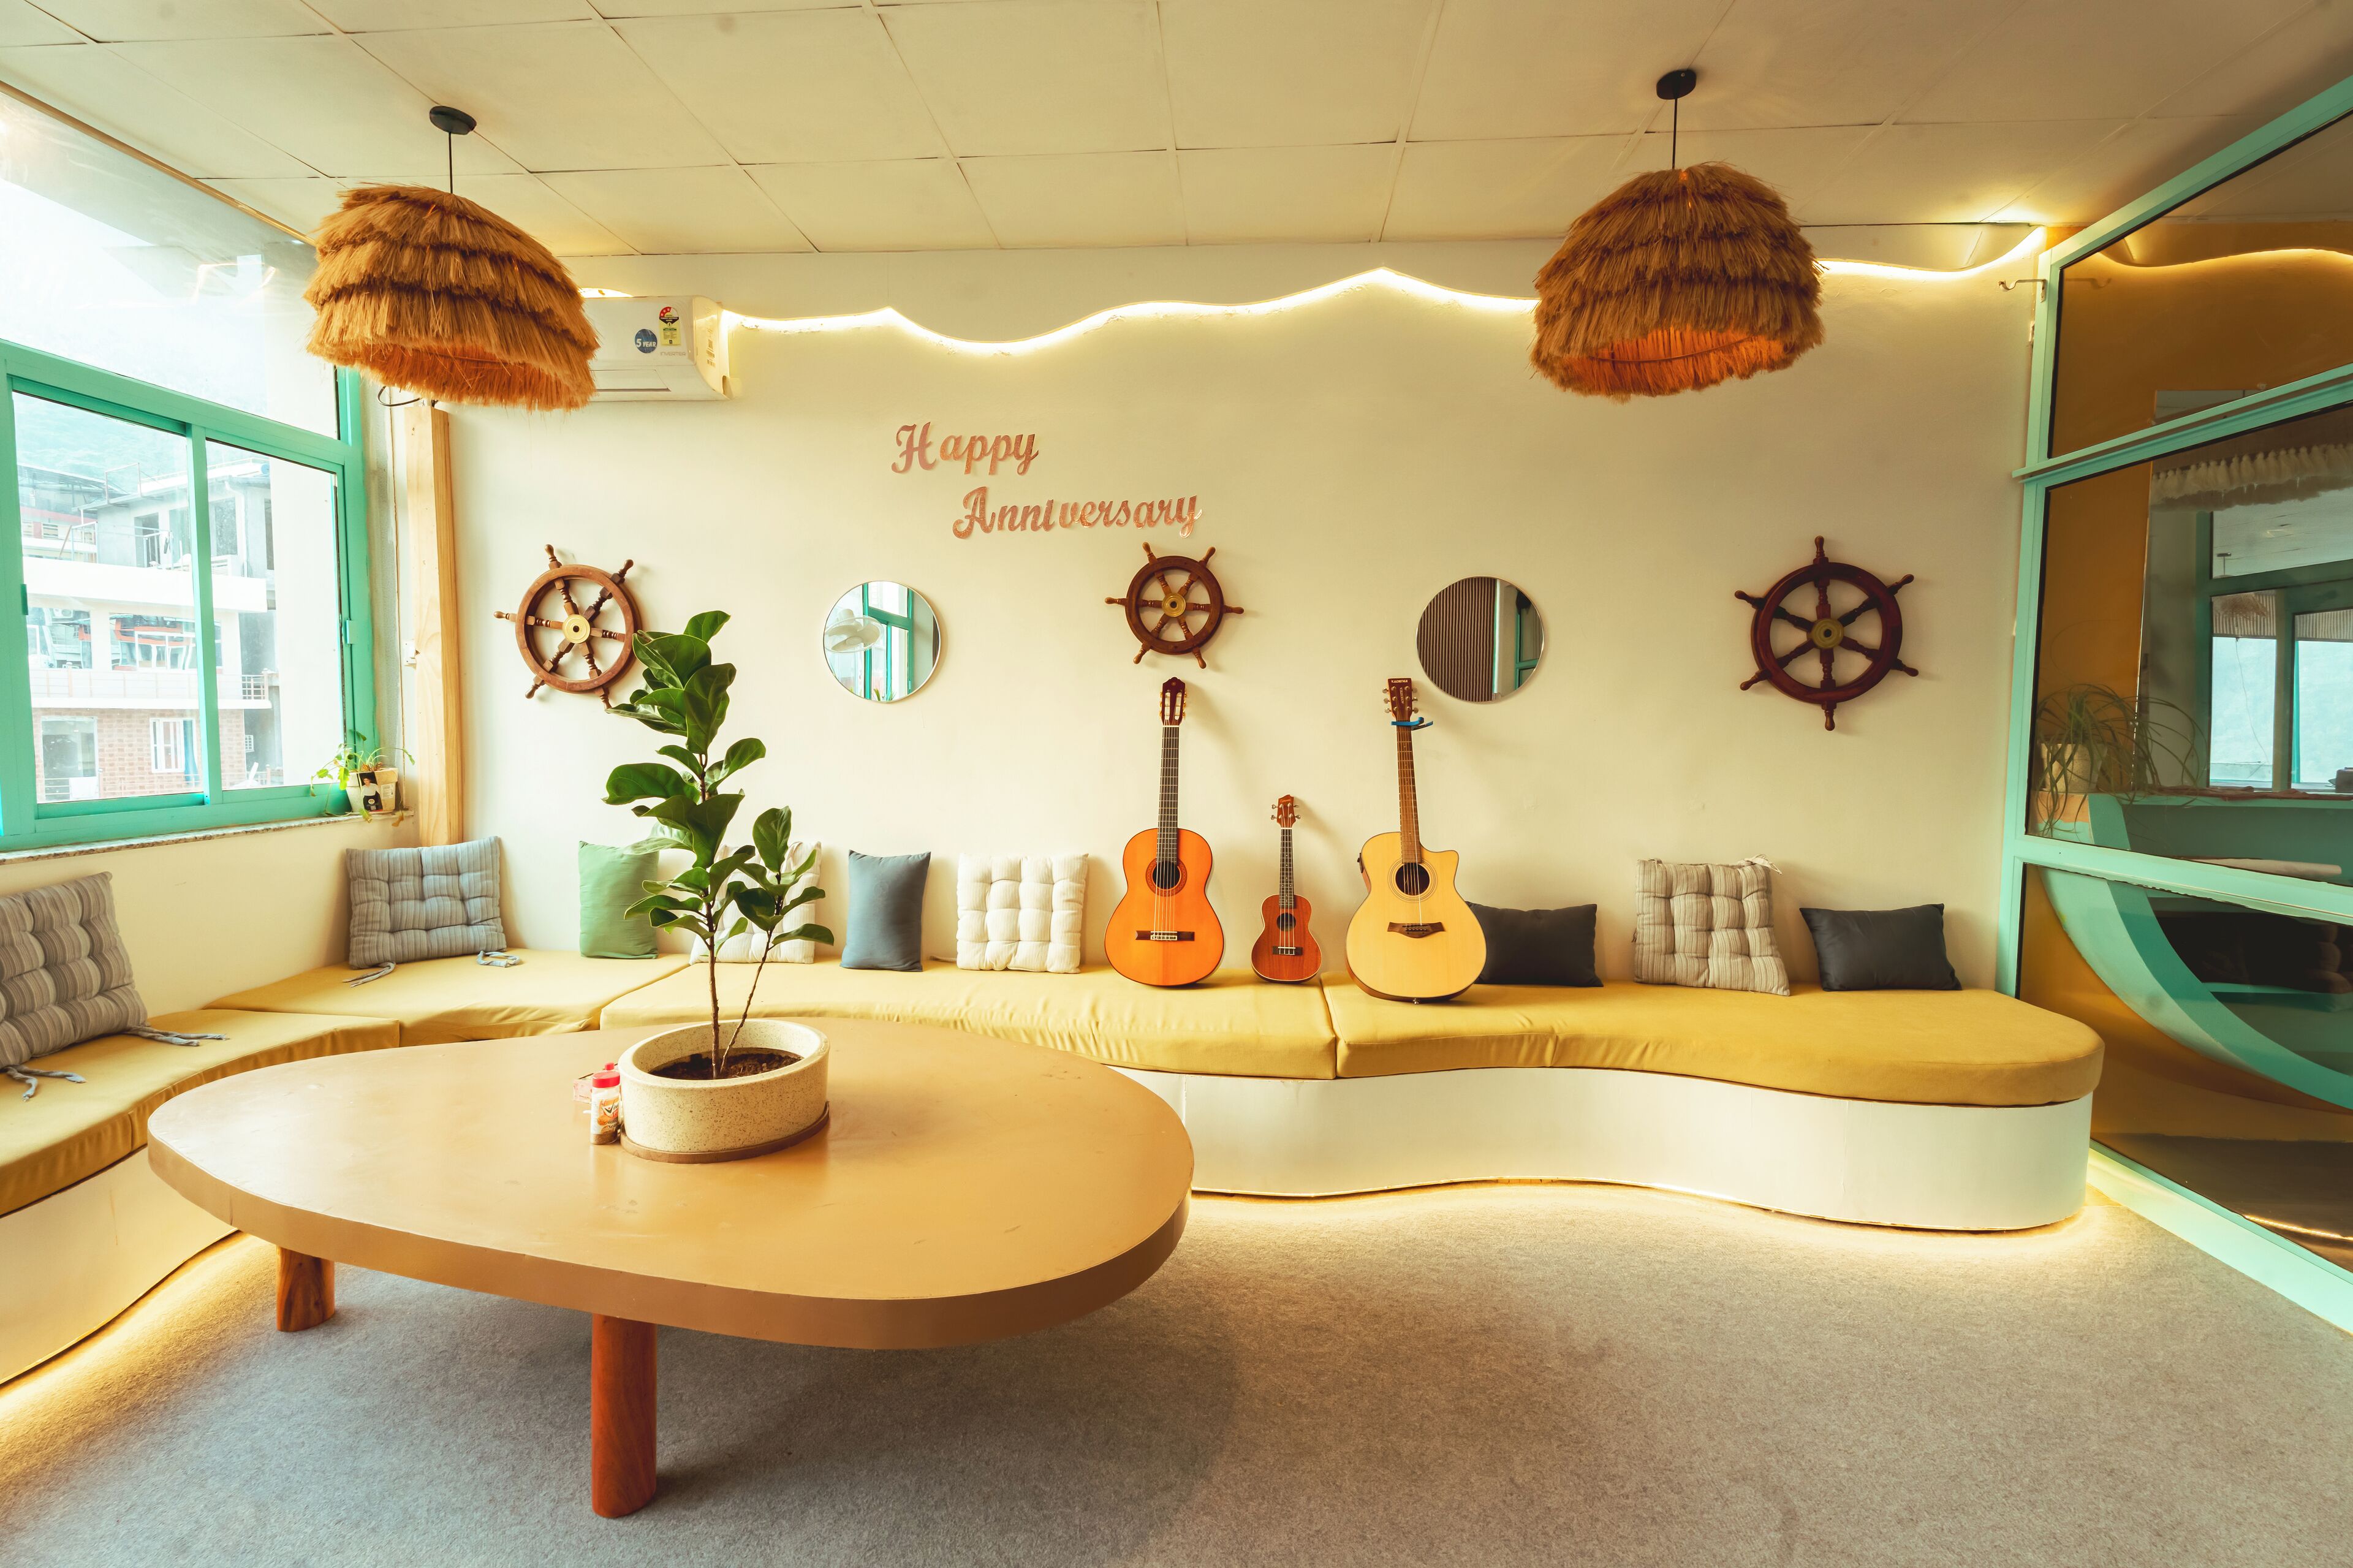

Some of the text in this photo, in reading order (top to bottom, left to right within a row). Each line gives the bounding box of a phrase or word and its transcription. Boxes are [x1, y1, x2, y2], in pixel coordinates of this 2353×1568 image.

[636, 338, 642, 347] 5
[891, 422, 1039, 475] Happy
[952, 487, 1202, 539] Anniversary
